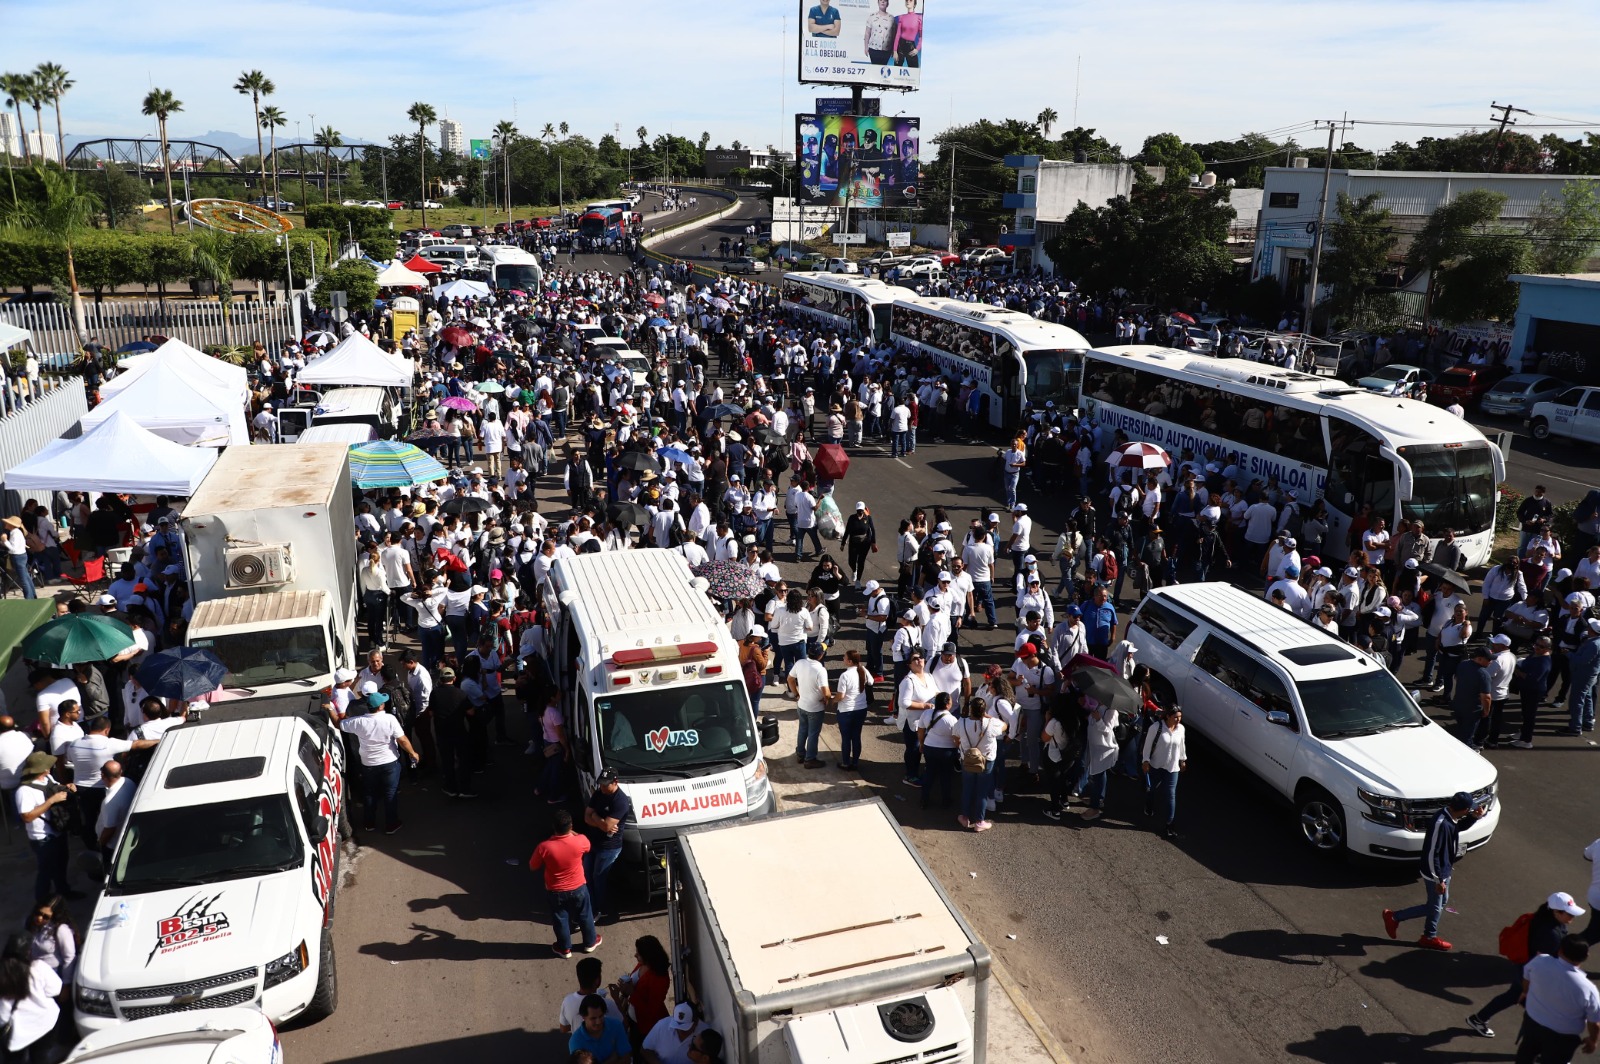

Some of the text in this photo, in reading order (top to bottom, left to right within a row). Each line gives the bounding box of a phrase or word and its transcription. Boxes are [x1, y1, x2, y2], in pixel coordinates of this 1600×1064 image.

[805, 39, 818, 48] DILE
[832, 66, 846, 74] 389
[847, 67, 856, 75] 52
[1101, 408, 1164, 441] UNIVERSIDAD
[1232, 450, 1248, 471] DE
[1250, 456, 1308, 491] SINALOA
[683, 665, 697, 674] UAS
[668, 731, 698, 747] UAS
[182, 911, 200, 922] LA
[159, 912, 227, 938] BESTIA
[161, 932, 232, 954] Dejando Huella
[162, 924, 218, 946] 102.5
